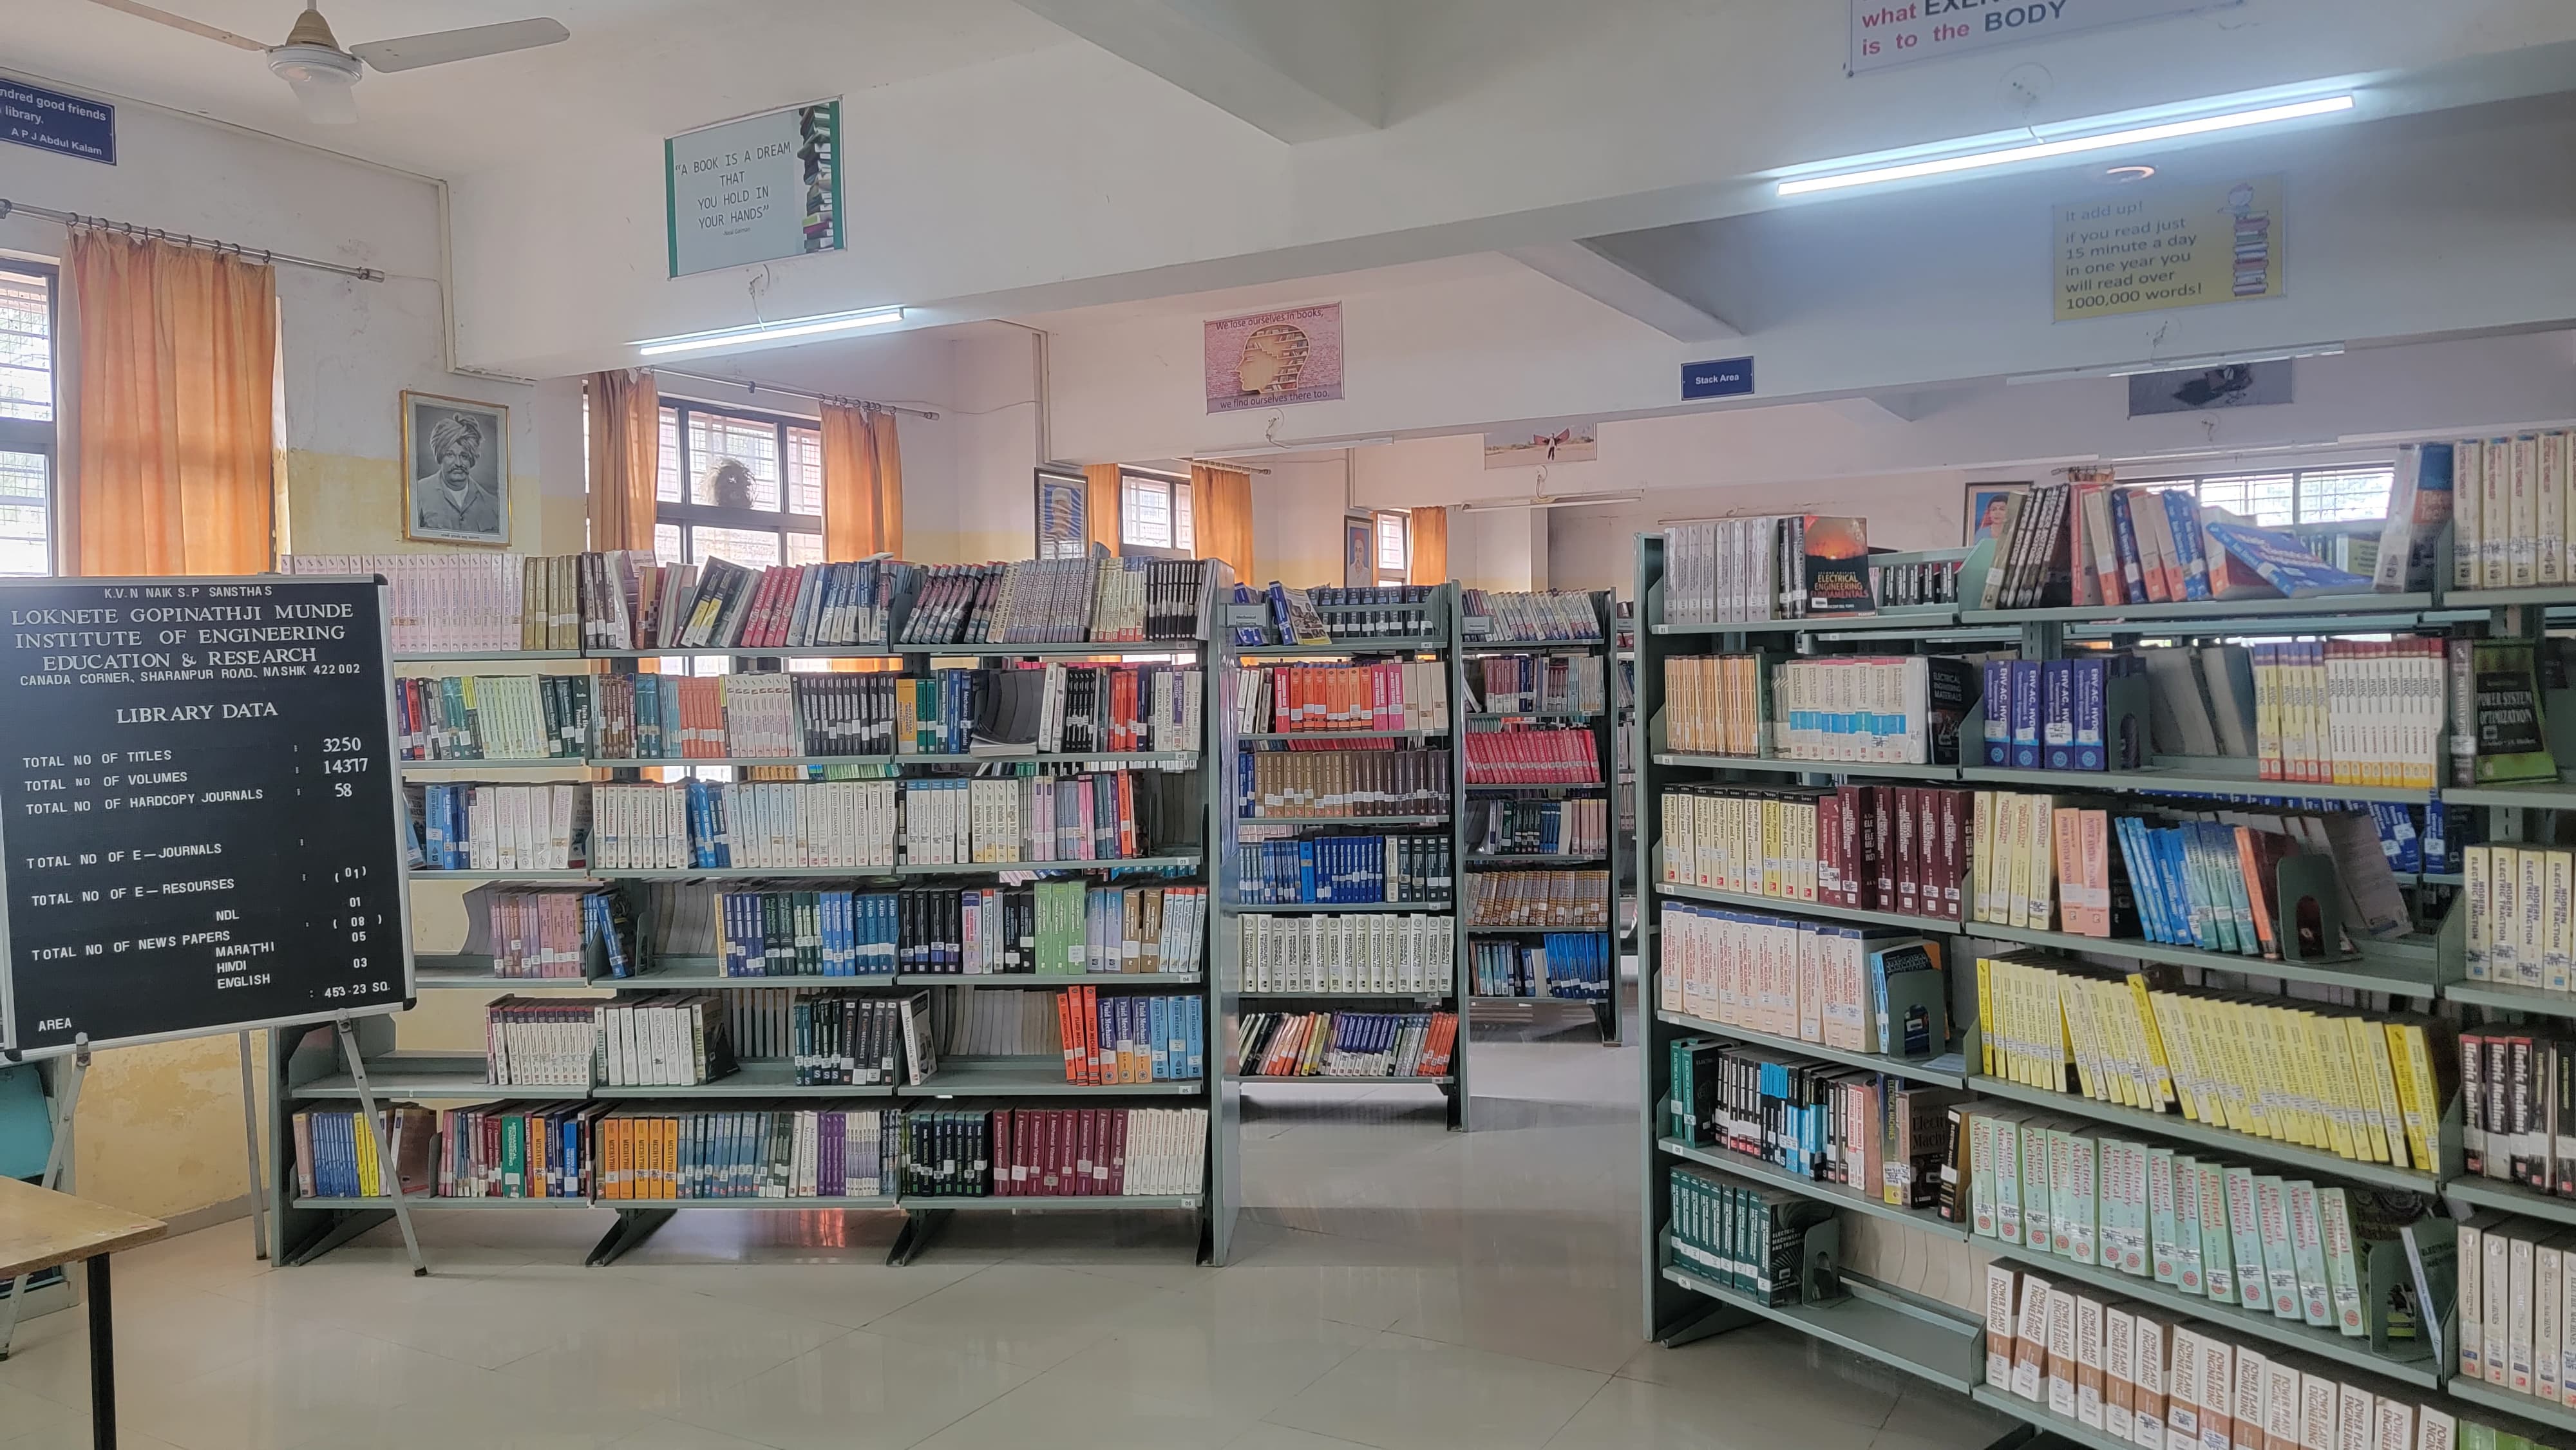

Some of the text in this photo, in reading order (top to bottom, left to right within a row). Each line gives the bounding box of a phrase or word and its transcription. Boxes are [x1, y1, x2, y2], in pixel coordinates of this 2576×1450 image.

[1862, 3, 1917, 28] what
[1862, 0, 2065, 56] is to the BODY
[5, 105, 44, 125] library.
[37, 97, 64, 111] good
[68, 104, 106, 121] friends
[11, 127, 19, 137] A
[22, 129, 28, 138] P
[40, 134, 68, 148] Abdul
[72, 141, 102, 155] Kalam
[694, 157, 719, 173] BOOK
[725, 153, 738, 166] IS
[744, 151, 752, 162] A
[757, 142, 791, 159] DREAM
[719, 171, 745, 186] THAT
[697, 185, 769, 210] YOU HOLD IN
[699, 214, 724, 229] YOUR
[2066, 209, 2076, 222] It
[2081, 205, 2112, 220] add
[2066, 217, 2186, 245] if you read just
[2067, 232, 2197, 260] 15 minute a day
[2066, 253, 2191, 277] in one year you
[2065, 270, 2175, 293] will read over
[2067, 282, 2202, 310] 1000,000 words!
[1216, 308, 1323, 330] We lose ourselves in books,
[1695, 374, 1718, 384] Stack
[1220, 390, 1330, 409] we find ourselves there too.
[1815, 582, 1862, 590] ENGINEERING
[1818, 574, 1859, 583] ELECTRICAL
[146, 588, 173, 598] NAIK
[11, 603, 354, 625] LOKNETE GOPINATHJI MUNDE
[15, 625, 346, 648] INSTITUTE OF ENGINEERING
[43, 647, 317, 671] EDUCATION & RESEARCH
[20, 674, 71, 686] CANADA
[140, 669, 214, 682] SHARANPUR
[263, 665, 307, 677] NASHIK
[116, 701, 279, 724] LIBRARY DATA
[22, 736, 361, 768] TOTAL NO OF TITLES 3250
[24, 757, 368, 792] TOTAL NO OF VOLUMES 14377
[25, 782, 353, 815] TOTAL NO OF HARDCOPY JOURNALS 58
[26, 855, 71, 869] TOTAL
[80, 853, 97, 865] NO
[108, 851, 125, 863] OF
[31, 892, 74, 907] TOTAL
[82, 890, 99, 902] NO
[109, 887, 127, 899] OF
[216, 896, 361, 921] NDL 01
[31, 916, 365, 961] TOTAL NO OF NEWS PAPERS 08
[215, 930, 366, 957] MARATHI 05
[216, 957, 368, 974] HINDI 03
[217, 973, 270, 990] ENGLISH
[38, 1017, 72, 1032] AREA
[2515, 1044, 2527, 1082] Electric
[1982, 1127, 1991, 1171] Electrical
[1991, 1277, 1999, 1329] ENGINEERING
